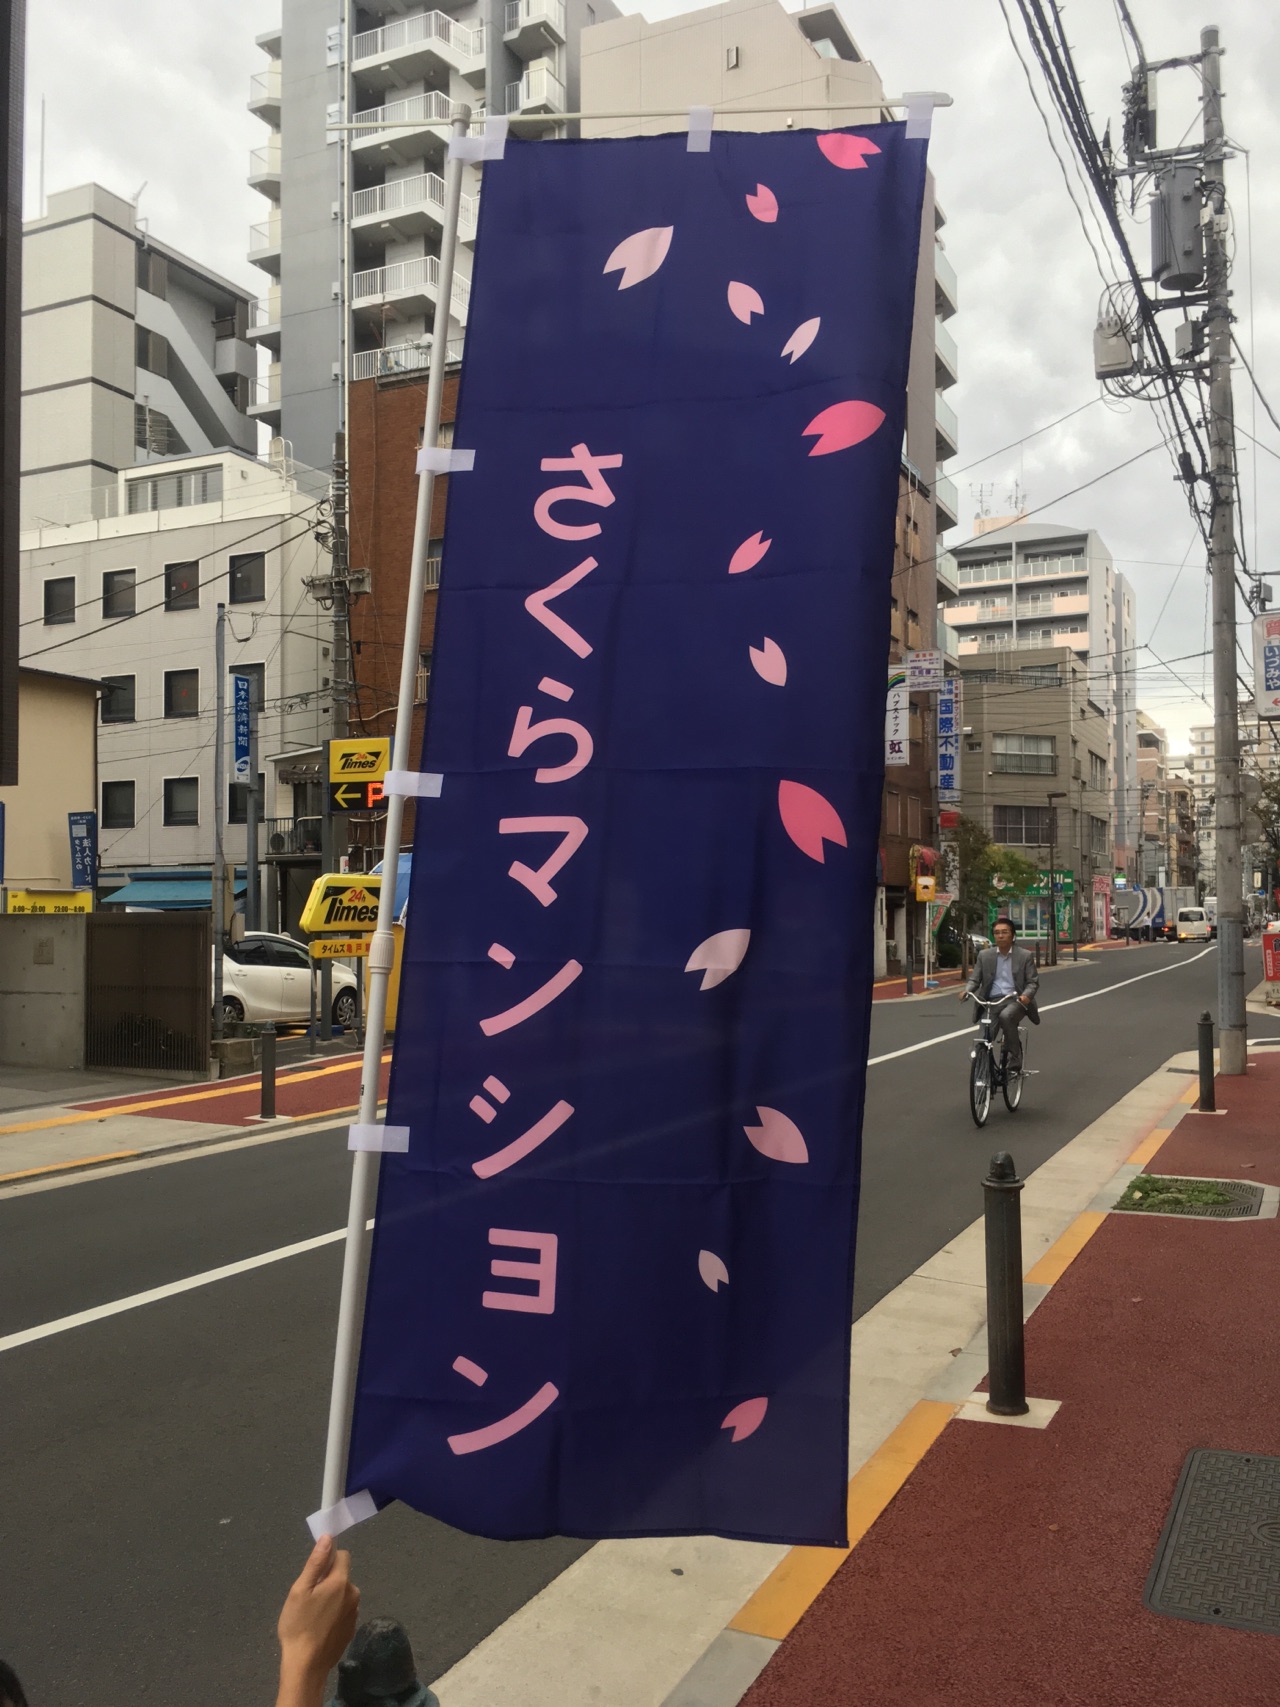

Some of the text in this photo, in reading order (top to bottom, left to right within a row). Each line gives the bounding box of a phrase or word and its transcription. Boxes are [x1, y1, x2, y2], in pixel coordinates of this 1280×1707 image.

[235, 680, 248, 746] 日本経済新聞
[339, 753, 380, 770] Times
[889, 740, 903, 754] 虹
[939, 698, 954, 790] 国際不動産
[321, 892, 379, 924] Times
[448, 443, 623, 1455] さくらマンション
